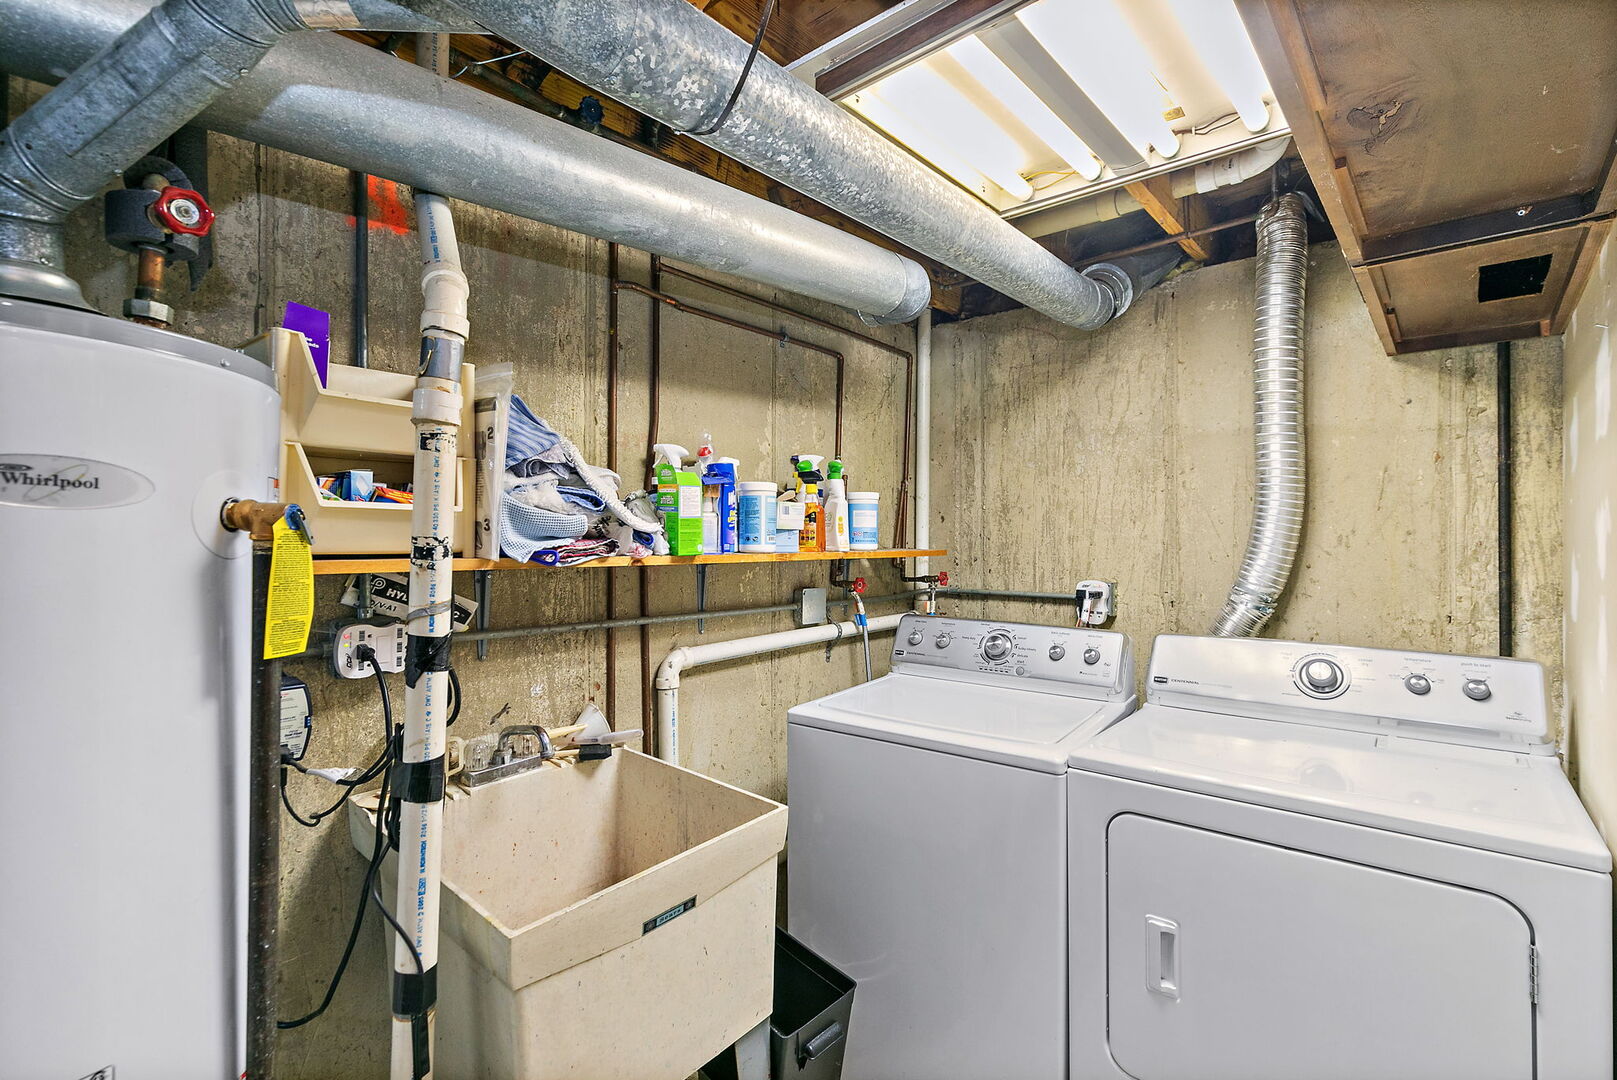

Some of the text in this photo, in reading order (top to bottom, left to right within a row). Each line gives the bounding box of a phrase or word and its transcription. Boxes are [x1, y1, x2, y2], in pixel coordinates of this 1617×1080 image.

[487, 426, 494, 439] 2
[1, 471, 100, 490] Whirlpool
[483, 518, 491, 531] 3
